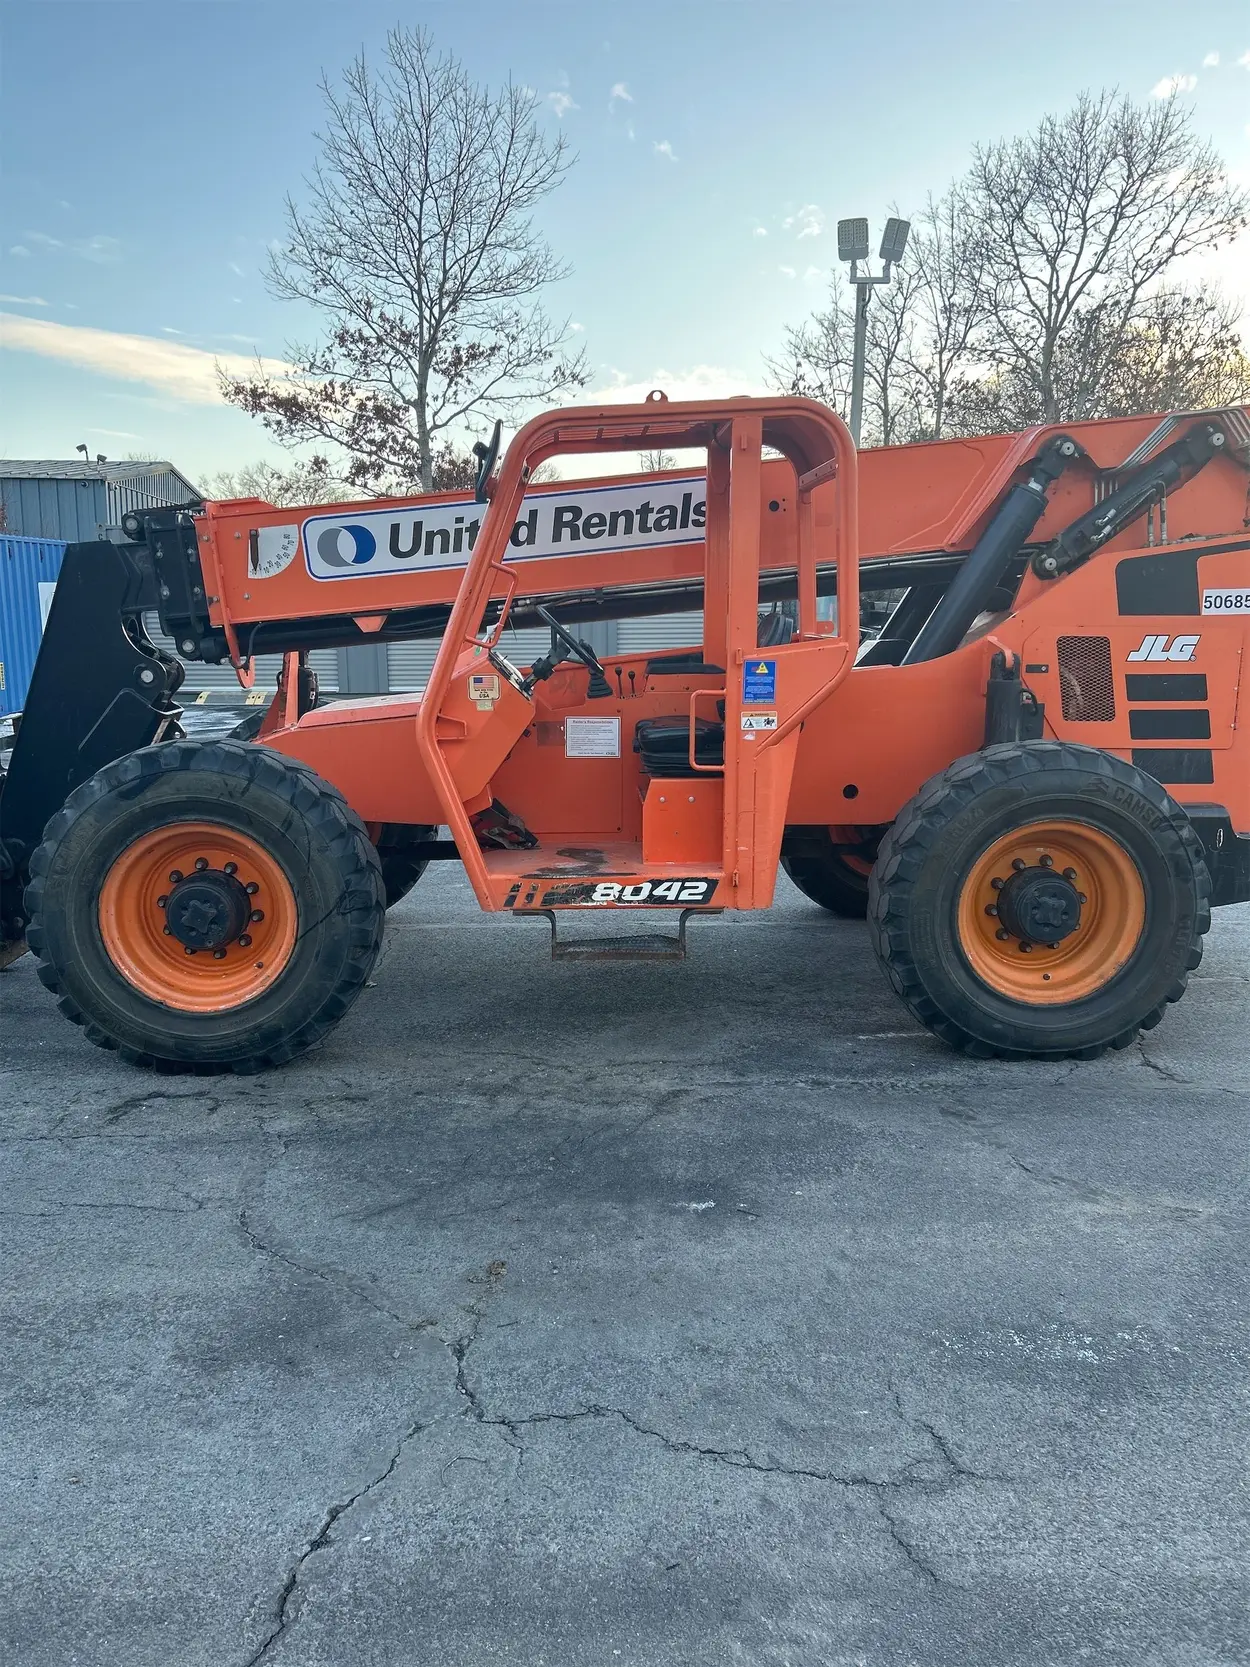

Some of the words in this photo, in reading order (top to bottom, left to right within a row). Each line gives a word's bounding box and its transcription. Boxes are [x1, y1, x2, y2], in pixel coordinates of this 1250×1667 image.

[389, 509, 538, 559] Unitd
[552, 493, 706, 543] Rentals
[1204, 595, 1250, 609] 50685
[1125, 634, 1201, 662] JLG
[592, 881, 708, 901] 8042
